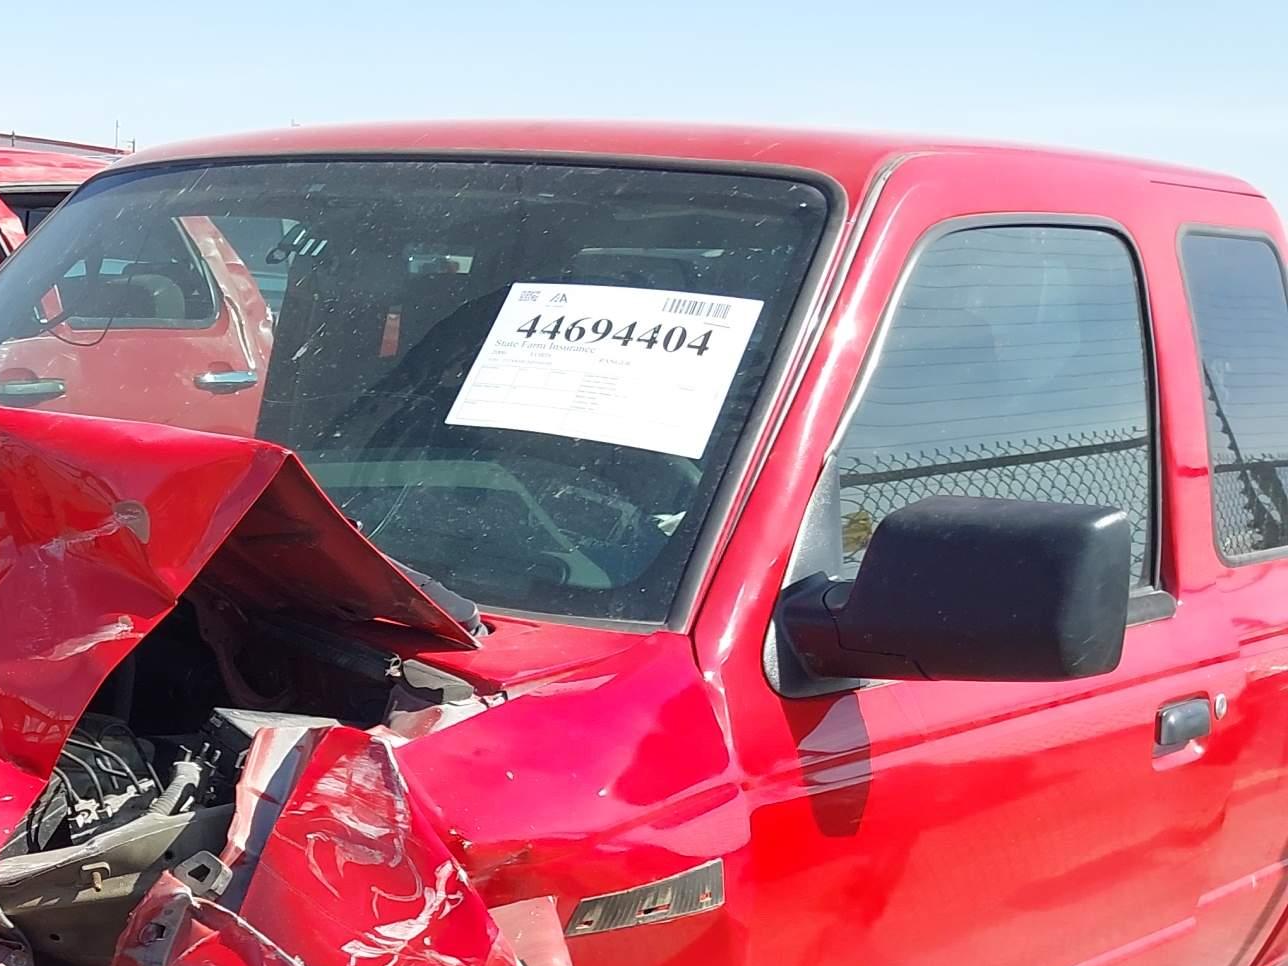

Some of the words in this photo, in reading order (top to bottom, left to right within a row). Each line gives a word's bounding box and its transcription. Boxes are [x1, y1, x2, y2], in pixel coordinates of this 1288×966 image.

[495, 339, 520, 349] State
[521, 341, 547, 351] Farm
[548, 342, 597, 355] Insurance
[516, 314, 713, 357] 44694404
